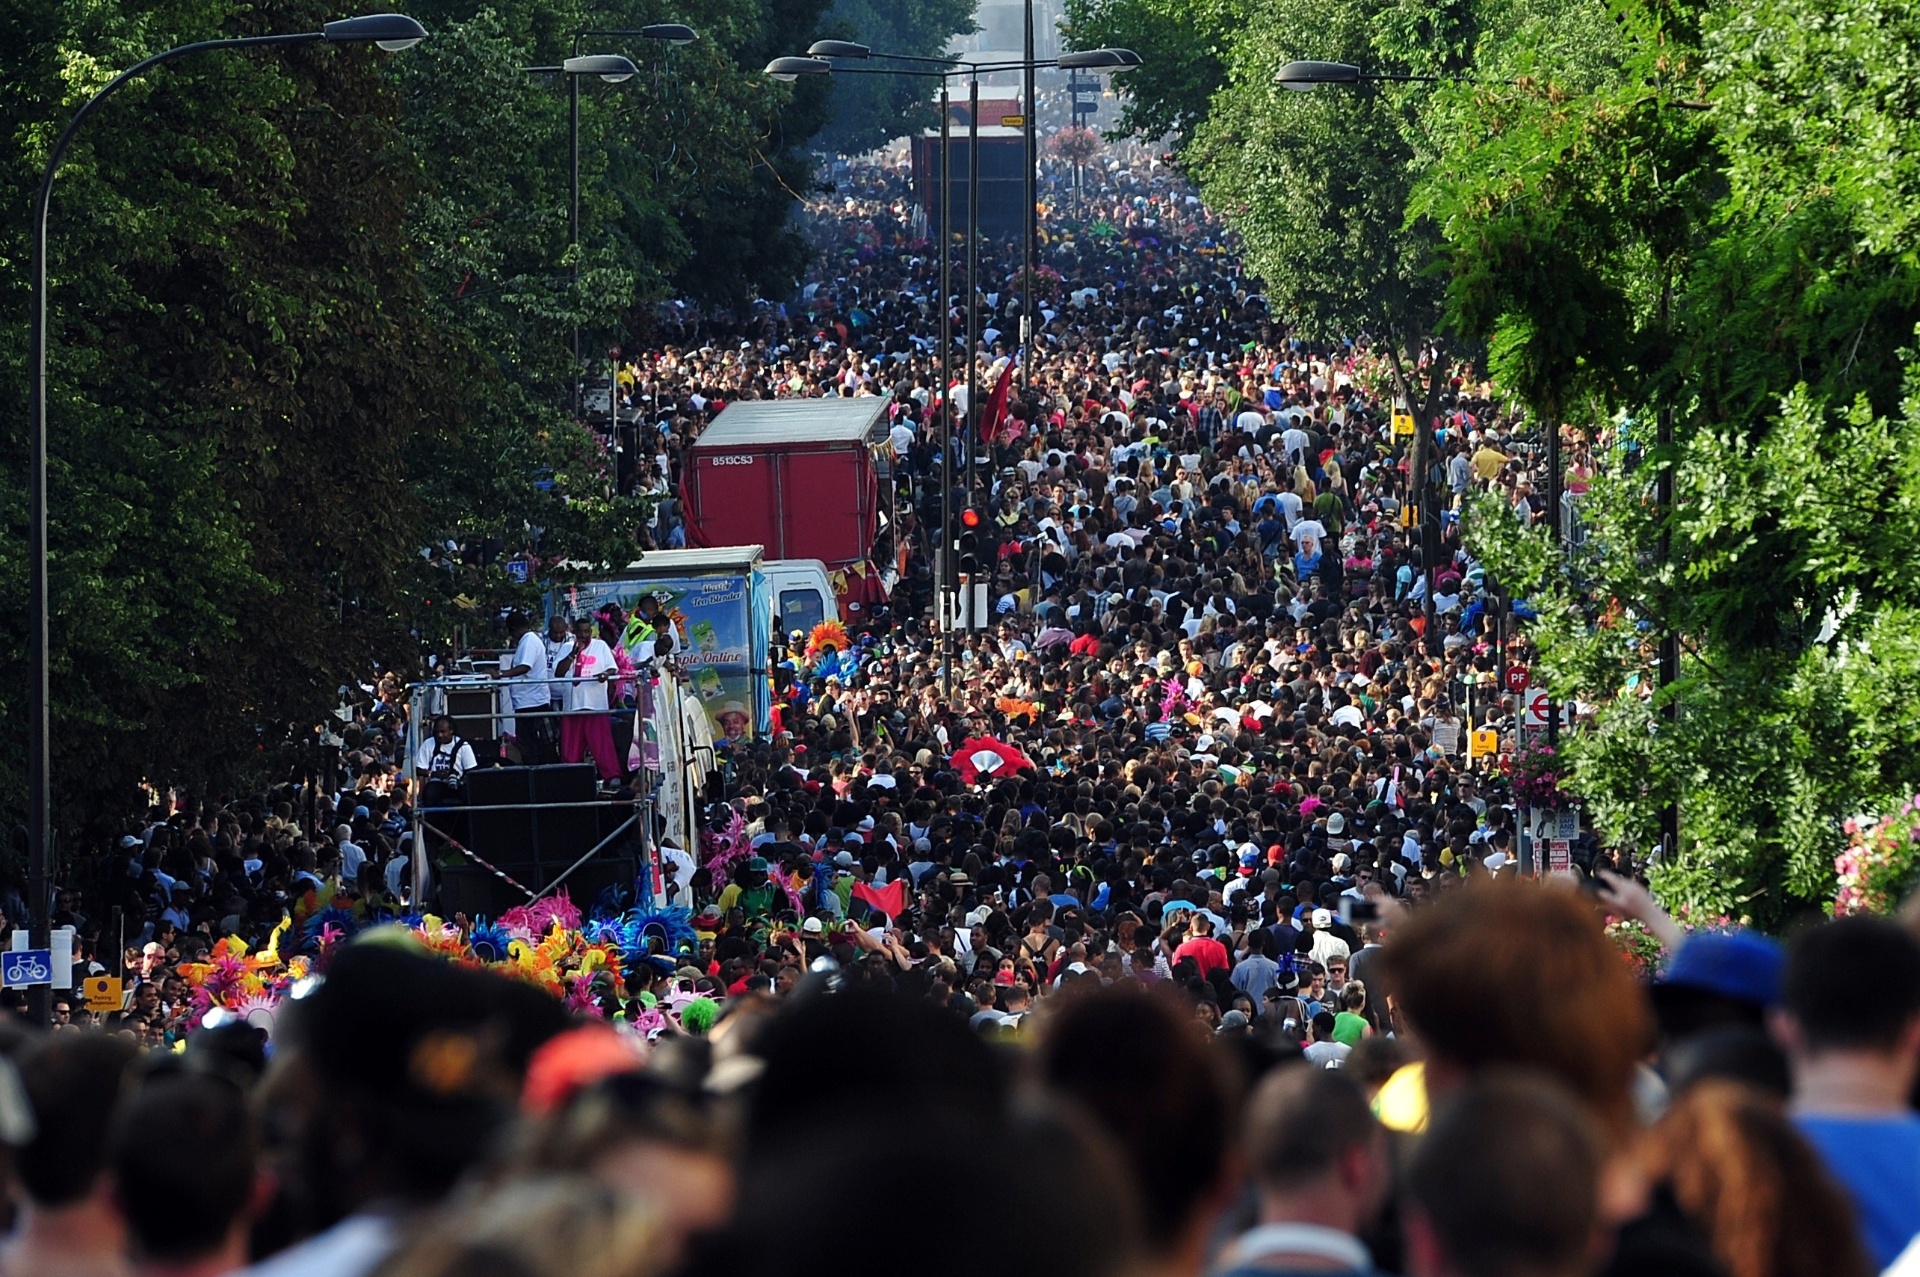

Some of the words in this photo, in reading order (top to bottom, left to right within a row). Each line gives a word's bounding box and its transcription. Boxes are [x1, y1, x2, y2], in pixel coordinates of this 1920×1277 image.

[712, 455, 753, 466] 8513CS3
[692, 597, 708, 607] Tea
[708, 592, 742, 604] Blender
[702, 651, 741, 664] Online
[1511, 674, 1525, 684] PF
